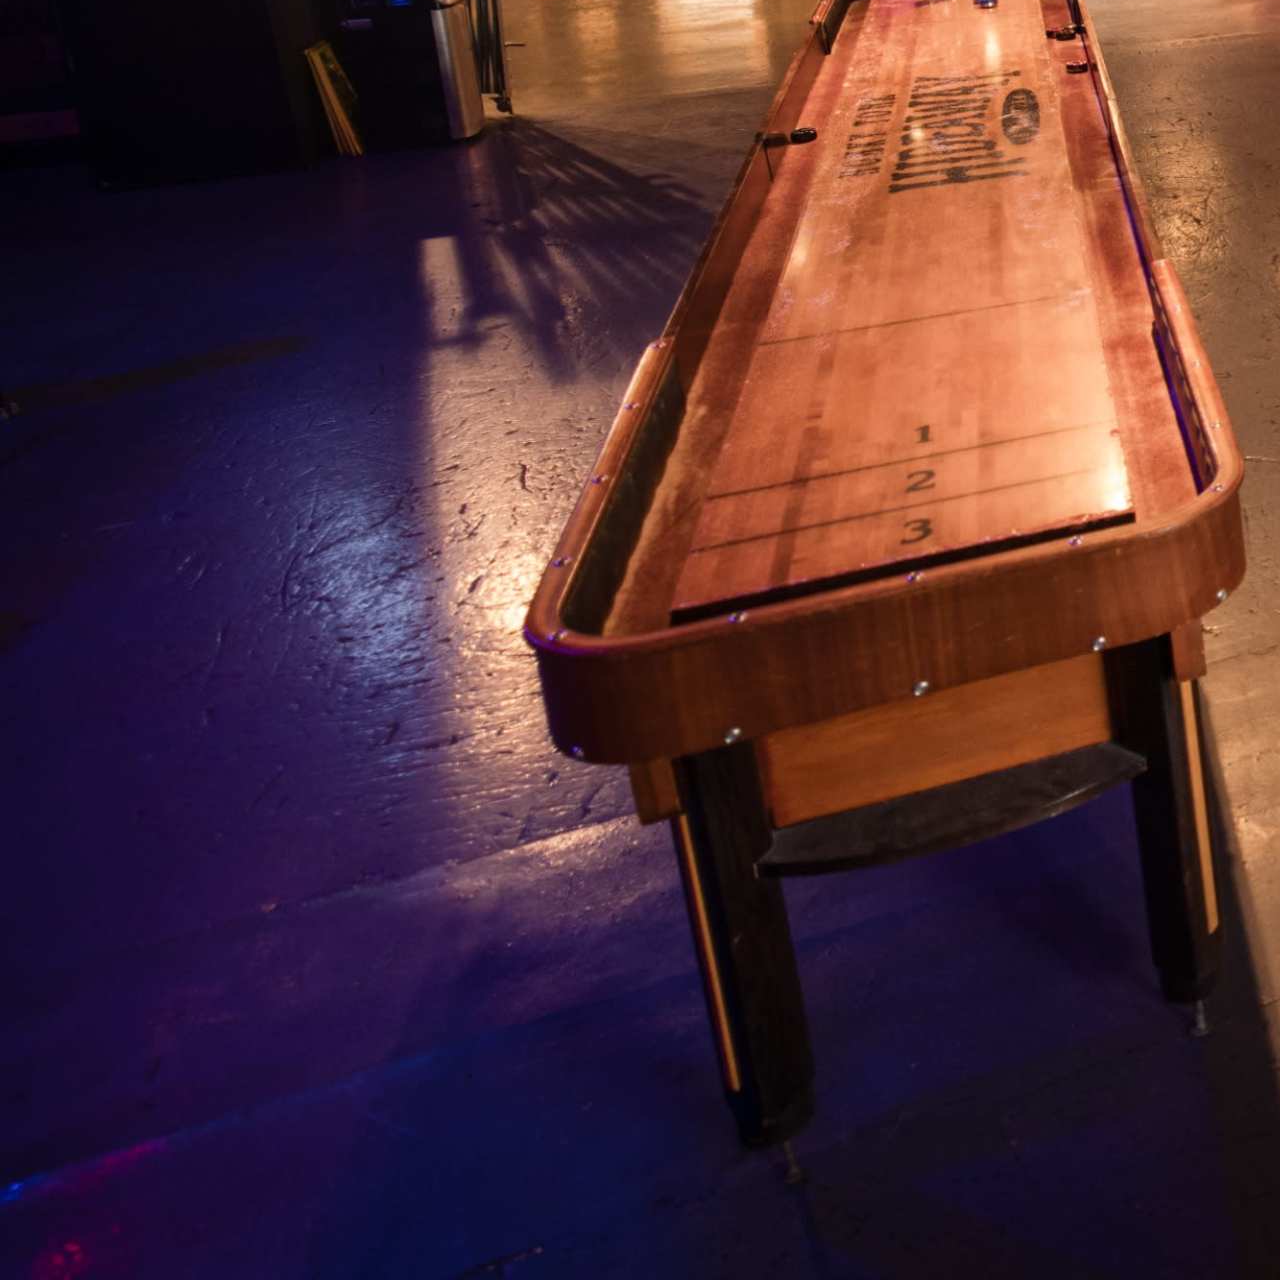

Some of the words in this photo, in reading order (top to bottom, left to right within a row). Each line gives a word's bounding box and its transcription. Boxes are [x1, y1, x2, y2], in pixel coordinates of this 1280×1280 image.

[913, 424, 933, 443] 1
[905, 469, 936, 493] 2
[900, 518, 934, 544] 3
